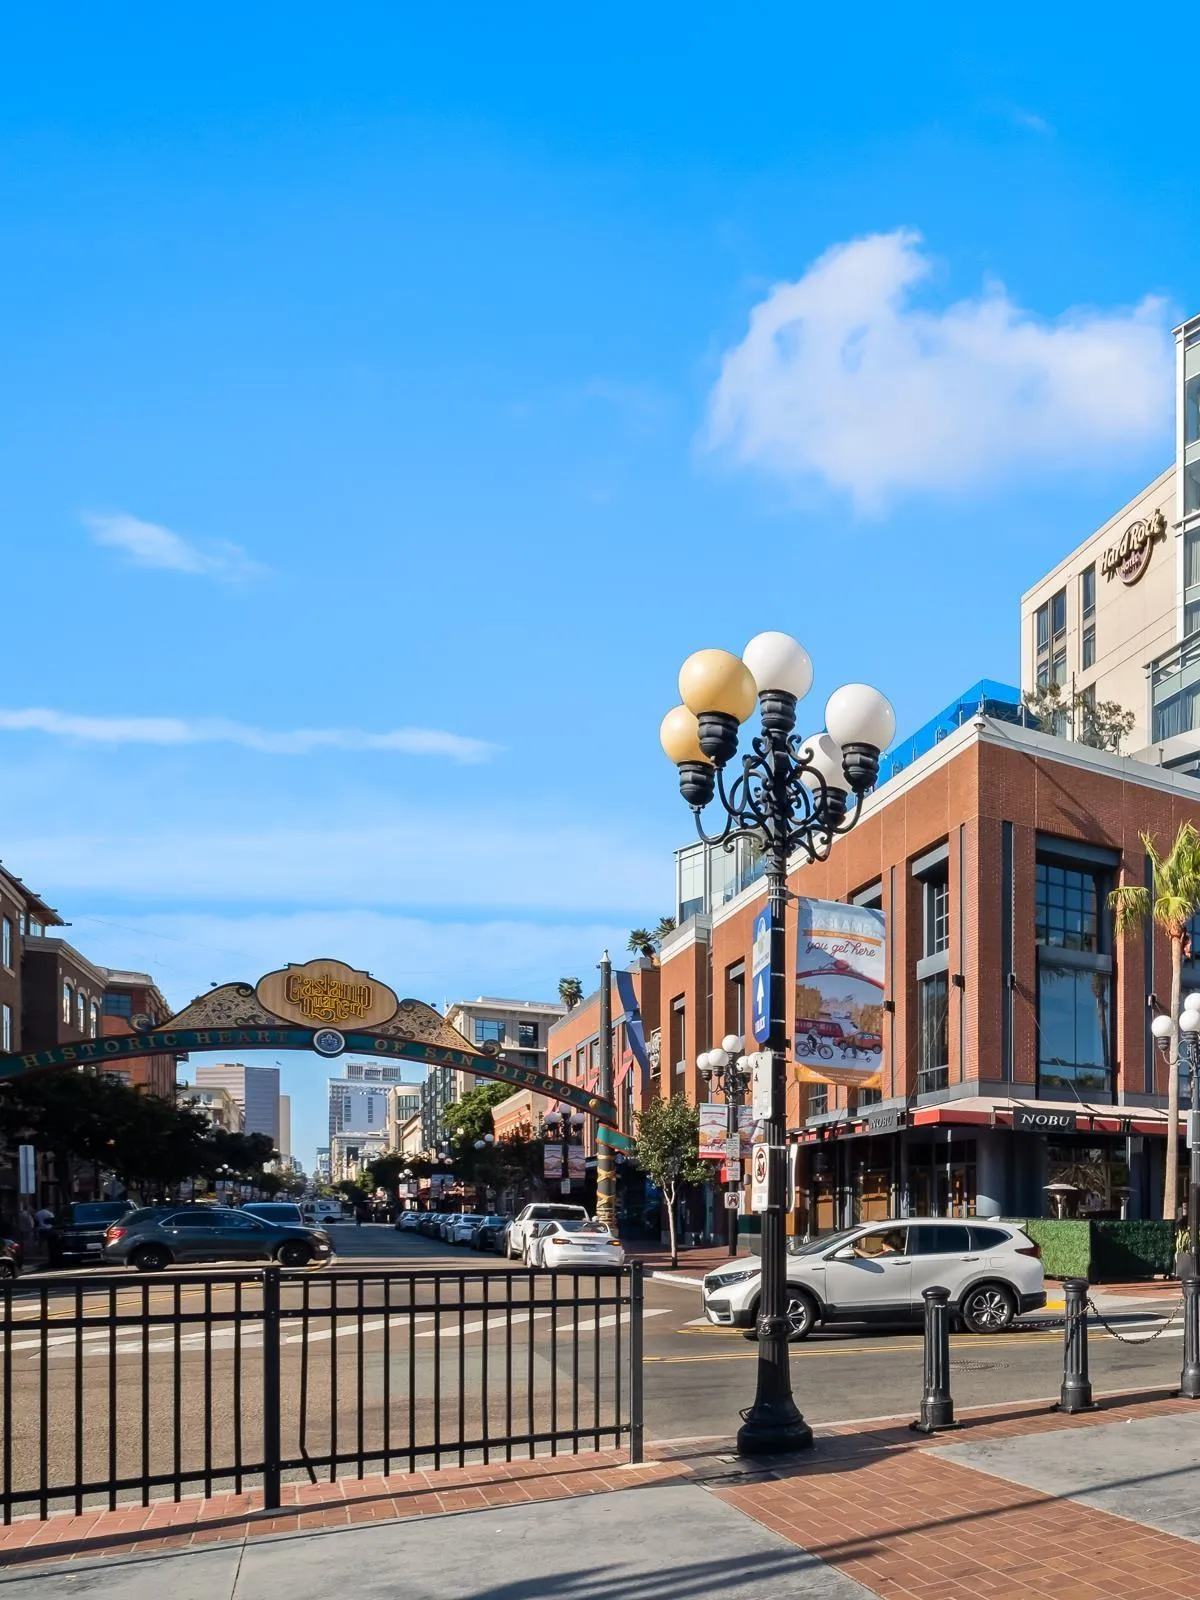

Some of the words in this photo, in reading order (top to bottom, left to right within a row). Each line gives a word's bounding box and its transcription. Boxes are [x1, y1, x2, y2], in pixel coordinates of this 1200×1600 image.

[805, 941, 829, 955] you
[830, 940, 852, 957] get
[851, 942, 876, 957] here
[19, 1034, 178, 1069] HISTORIC
[194, 1030, 290, 1045] HEART
[374, 1039, 406, 1053] OF
[424, 1047, 475, 1067] SAN
[492, 1062, 572, 1097] DIEGO
[869, 1114, 895, 1129] NOBU
[1020, 1113, 1071, 1127] NOBU
